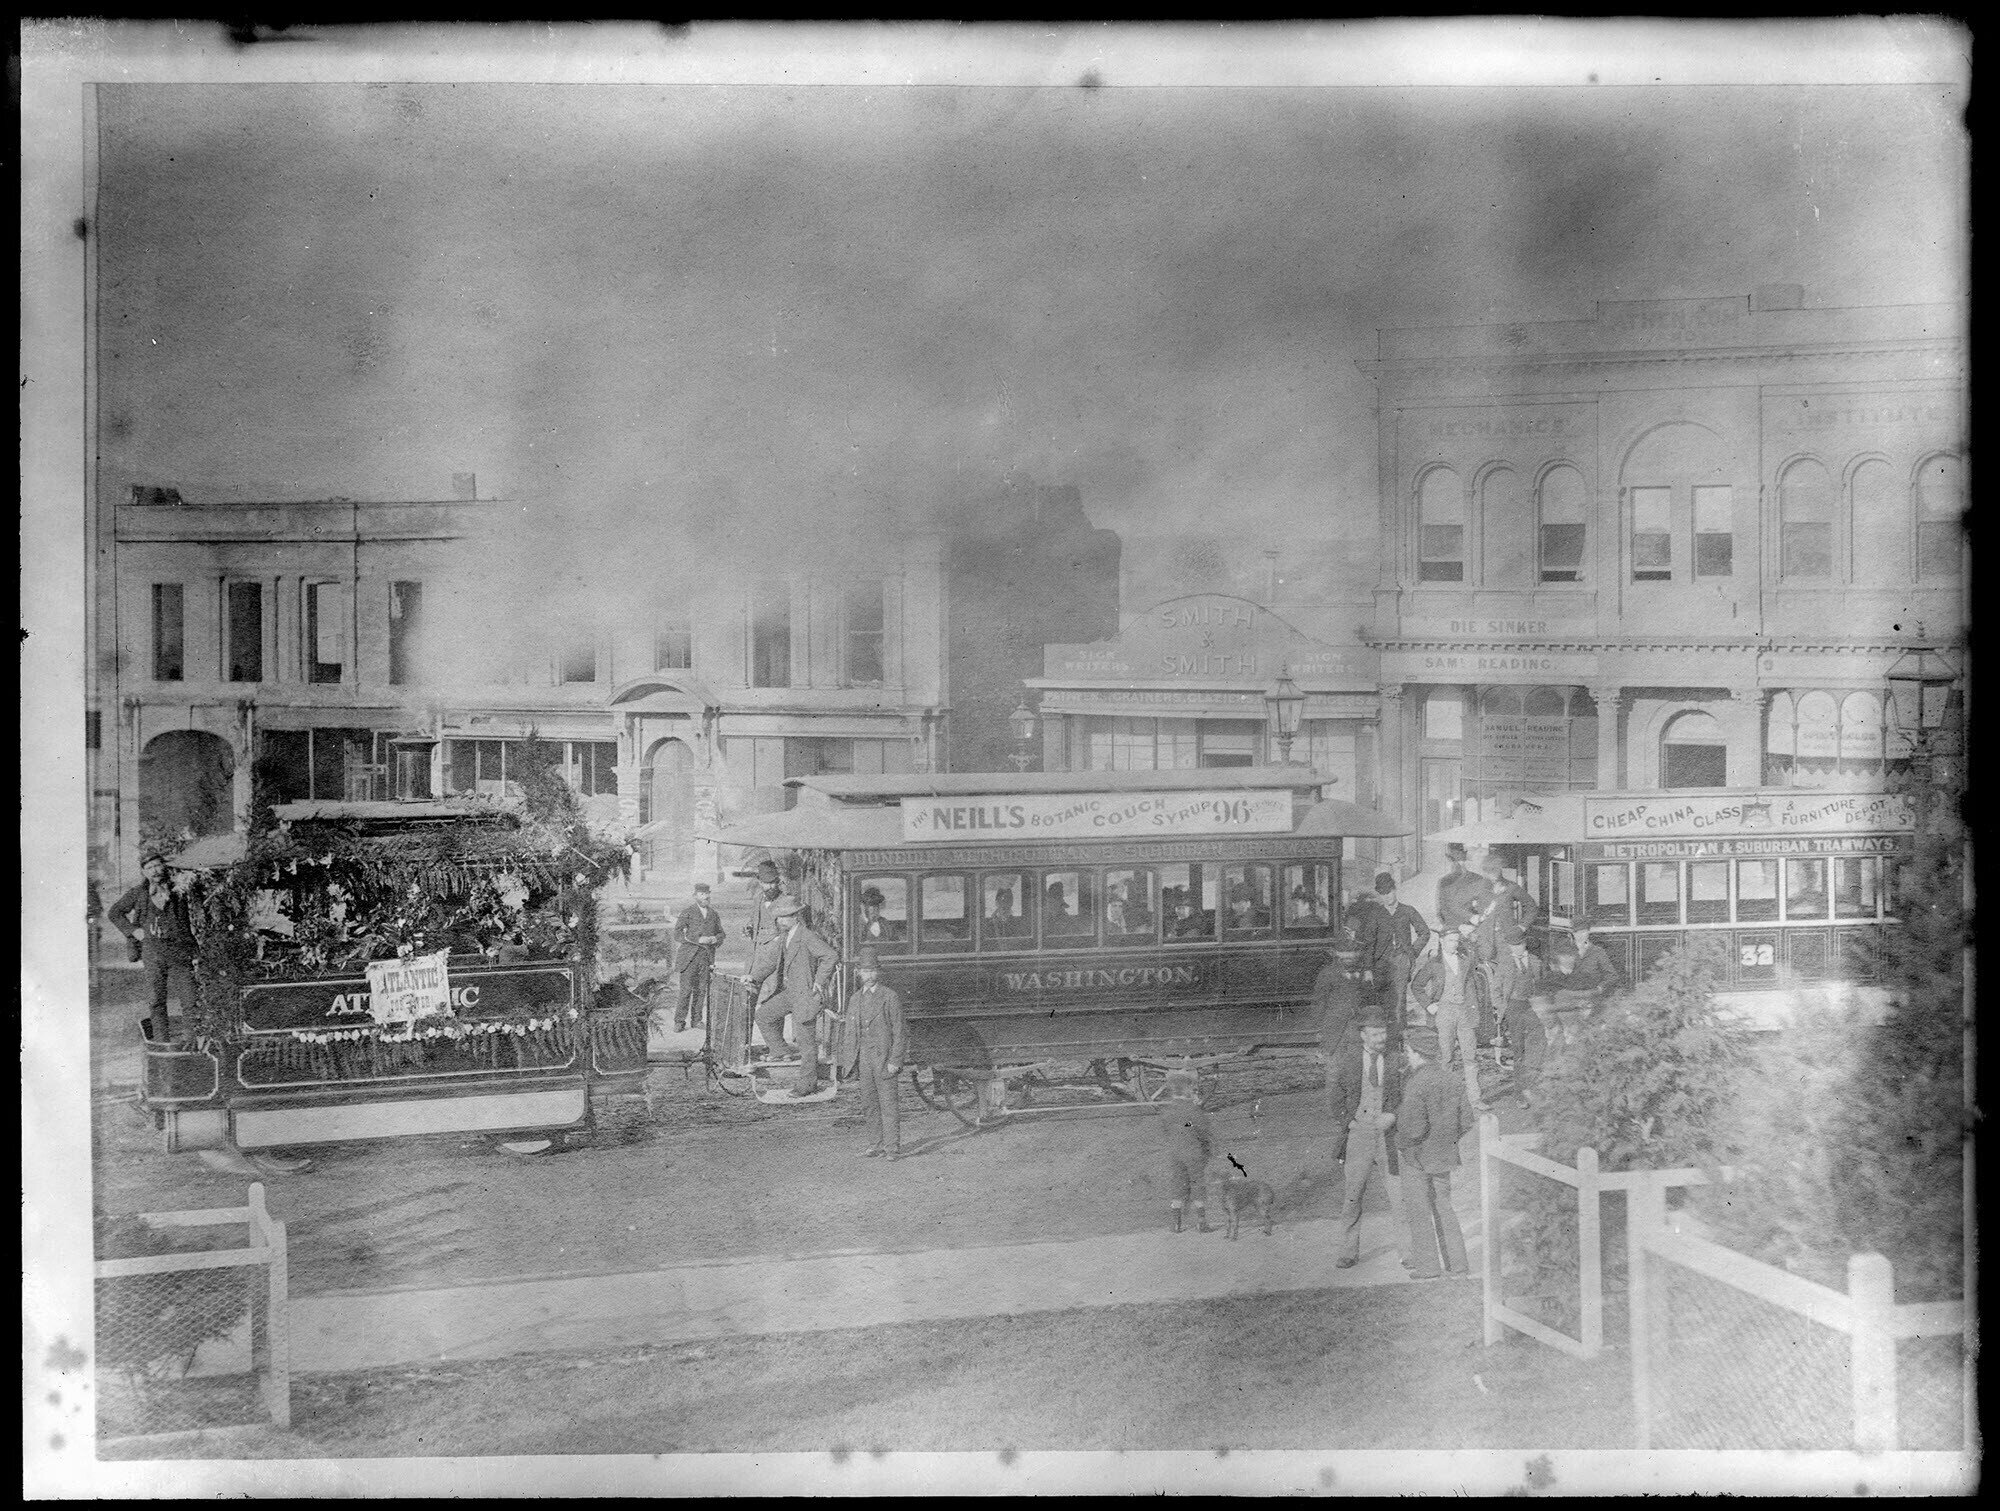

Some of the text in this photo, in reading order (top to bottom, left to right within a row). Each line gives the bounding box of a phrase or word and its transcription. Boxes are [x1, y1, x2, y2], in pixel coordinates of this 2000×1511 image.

[1161, 606, 1255, 630] SMITH
[1450, 620, 1477, 633] DIE
[1200, 630, 1215, 649] &
[1079, 650, 1115, 660] SIGN
[1161, 655, 1257, 675] SMITH
[1305, 652, 1342, 662] SIGN
[932, 805, 1026, 830] NEILL'S
[1031, 800, 1101, 827] BOTANIC
[1152, 800, 1211, 826] SYRUP
[1212, 799, 1250, 824] 96
[1593, 804, 1647, 829] CHEAP
[1645, 805, 1694, 829] CHINA
[1781, 799, 1857, 826] FURNITURE
[1786, 801, 1795, 811] &
[1845, 800, 1886, 825] DEPOT
[1603, 841, 1719, 857] METROPOLITAN
[1722, 842, 1735, 854] &
[1736, 839, 1809, 854] SUBURBAN
[326, 985, 480, 1016] ATIC
